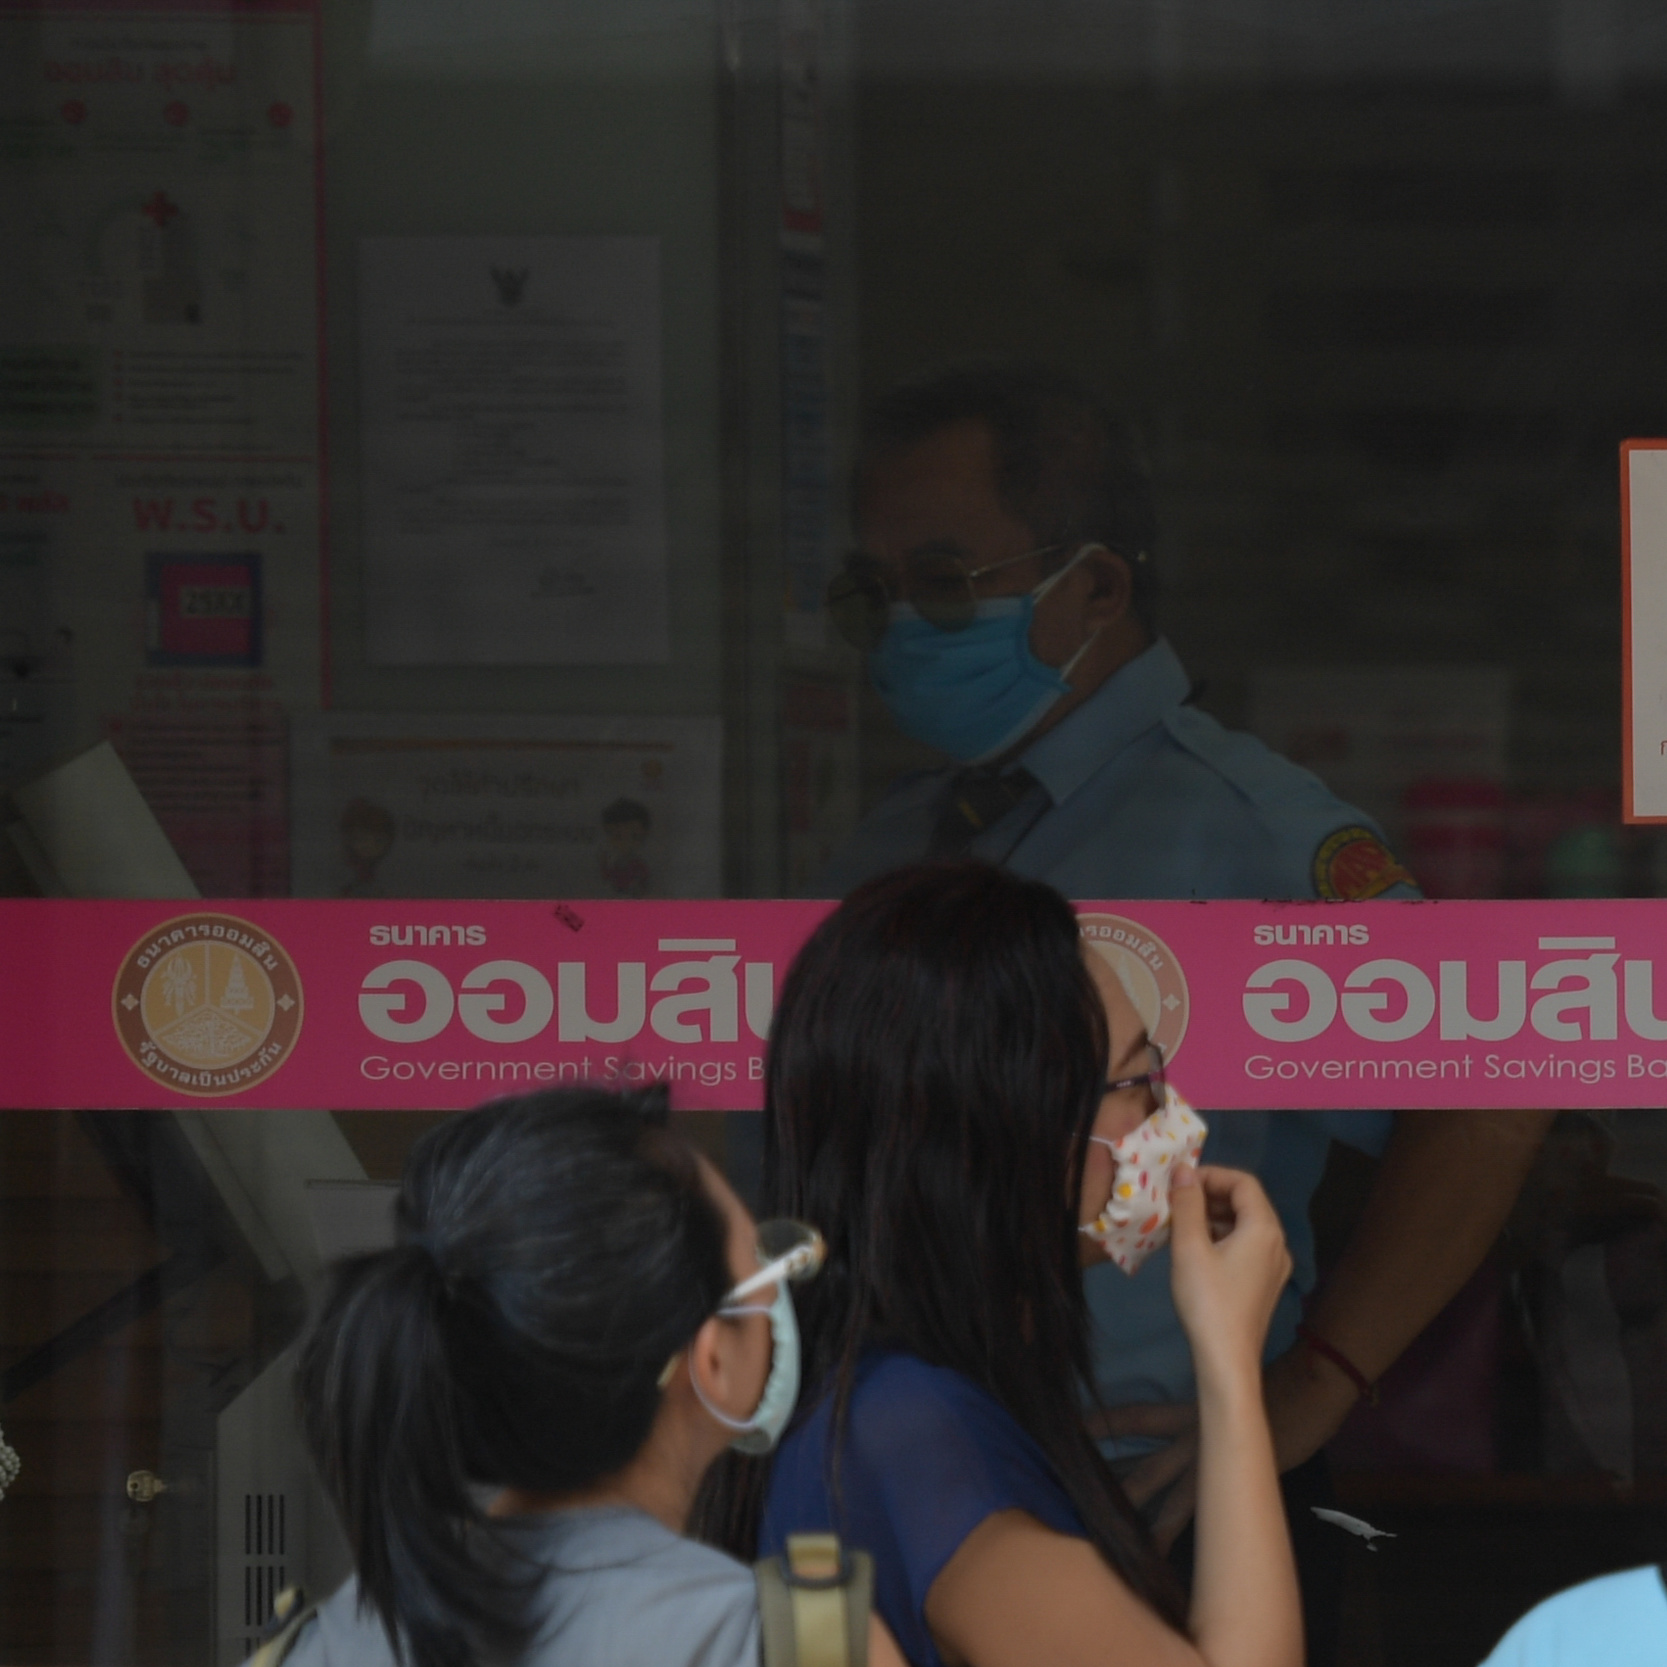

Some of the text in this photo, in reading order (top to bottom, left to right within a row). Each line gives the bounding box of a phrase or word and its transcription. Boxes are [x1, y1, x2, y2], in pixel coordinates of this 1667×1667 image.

[134, 914, 280, 972] ธนาคารออมสิน
[368, 924, 487, 947] ธนาคาร
[1253, 922, 1370, 946] ธนาคาร
[138, 1039, 285, 1087] รัฐบาลเป็นประกัน
[359, 1054, 592, 1082] Government
[601, 1054, 738, 1086] Savings
[1244, 1054, 1472, 1081] Government
[1483, 1053, 1616, 1086] Savings
